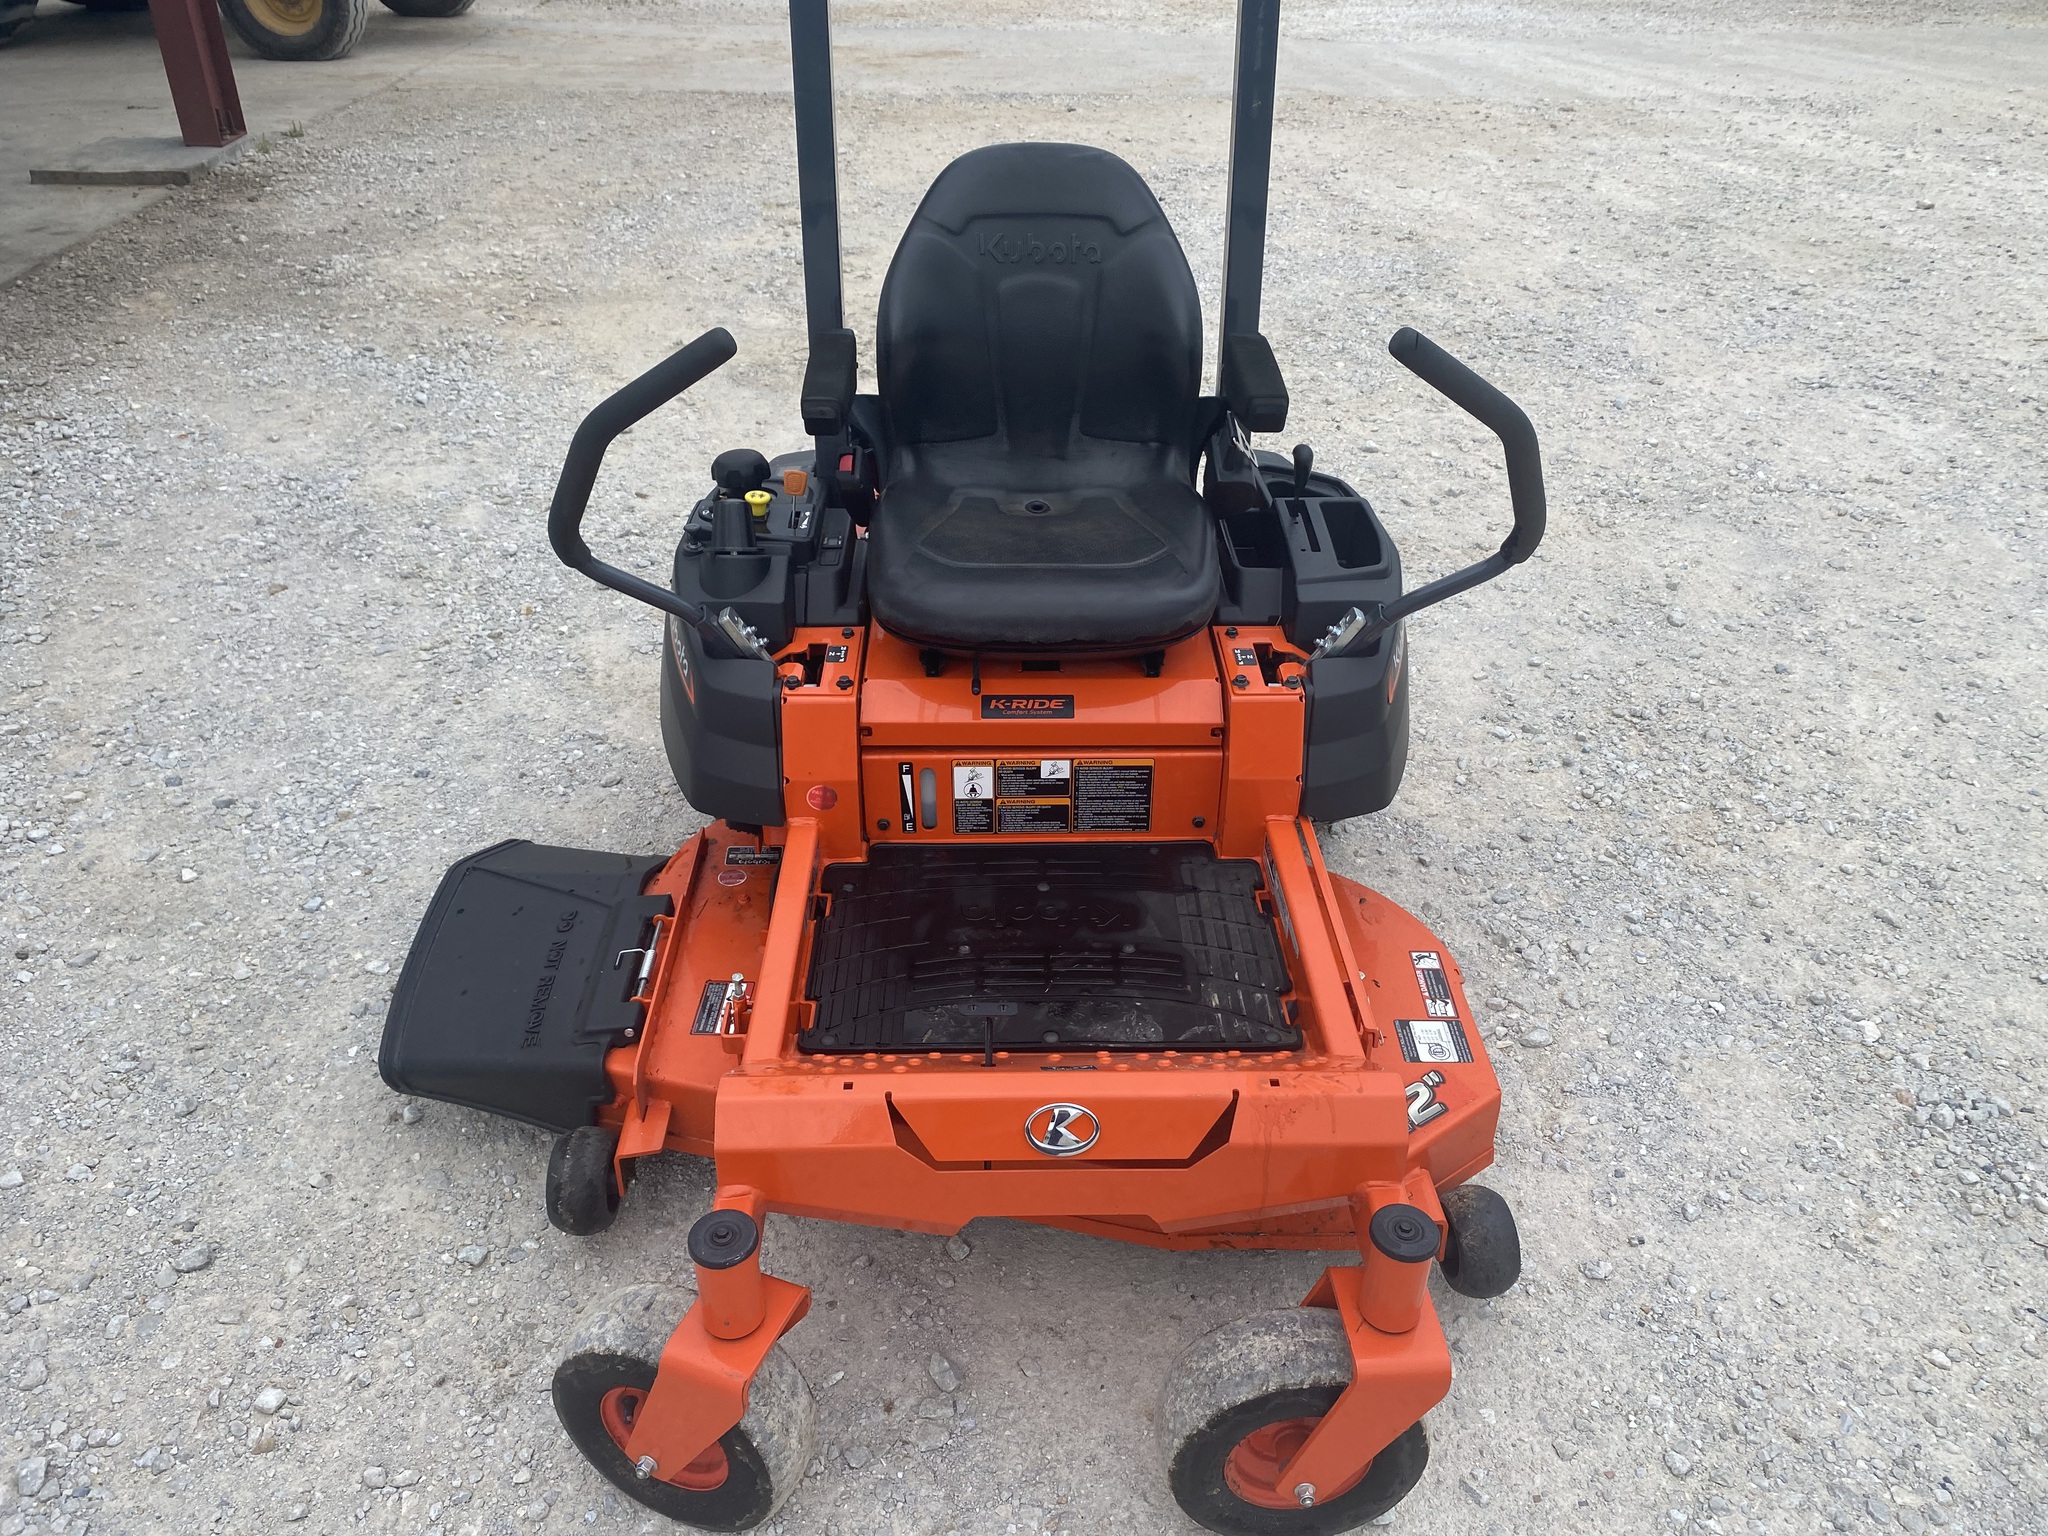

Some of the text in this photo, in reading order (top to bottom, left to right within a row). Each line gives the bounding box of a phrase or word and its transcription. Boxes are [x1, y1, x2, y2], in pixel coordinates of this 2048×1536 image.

[978, 232, 1102, 264] Kubota
[989, 699, 1066, 709] K-RIDE
[902, 764, 910, 773] F
[906, 823, 914, 831] E
[521, 910, 578, 1049] DO NOT REMOVE
[1405, 1070, 1449, 1134] 2"
